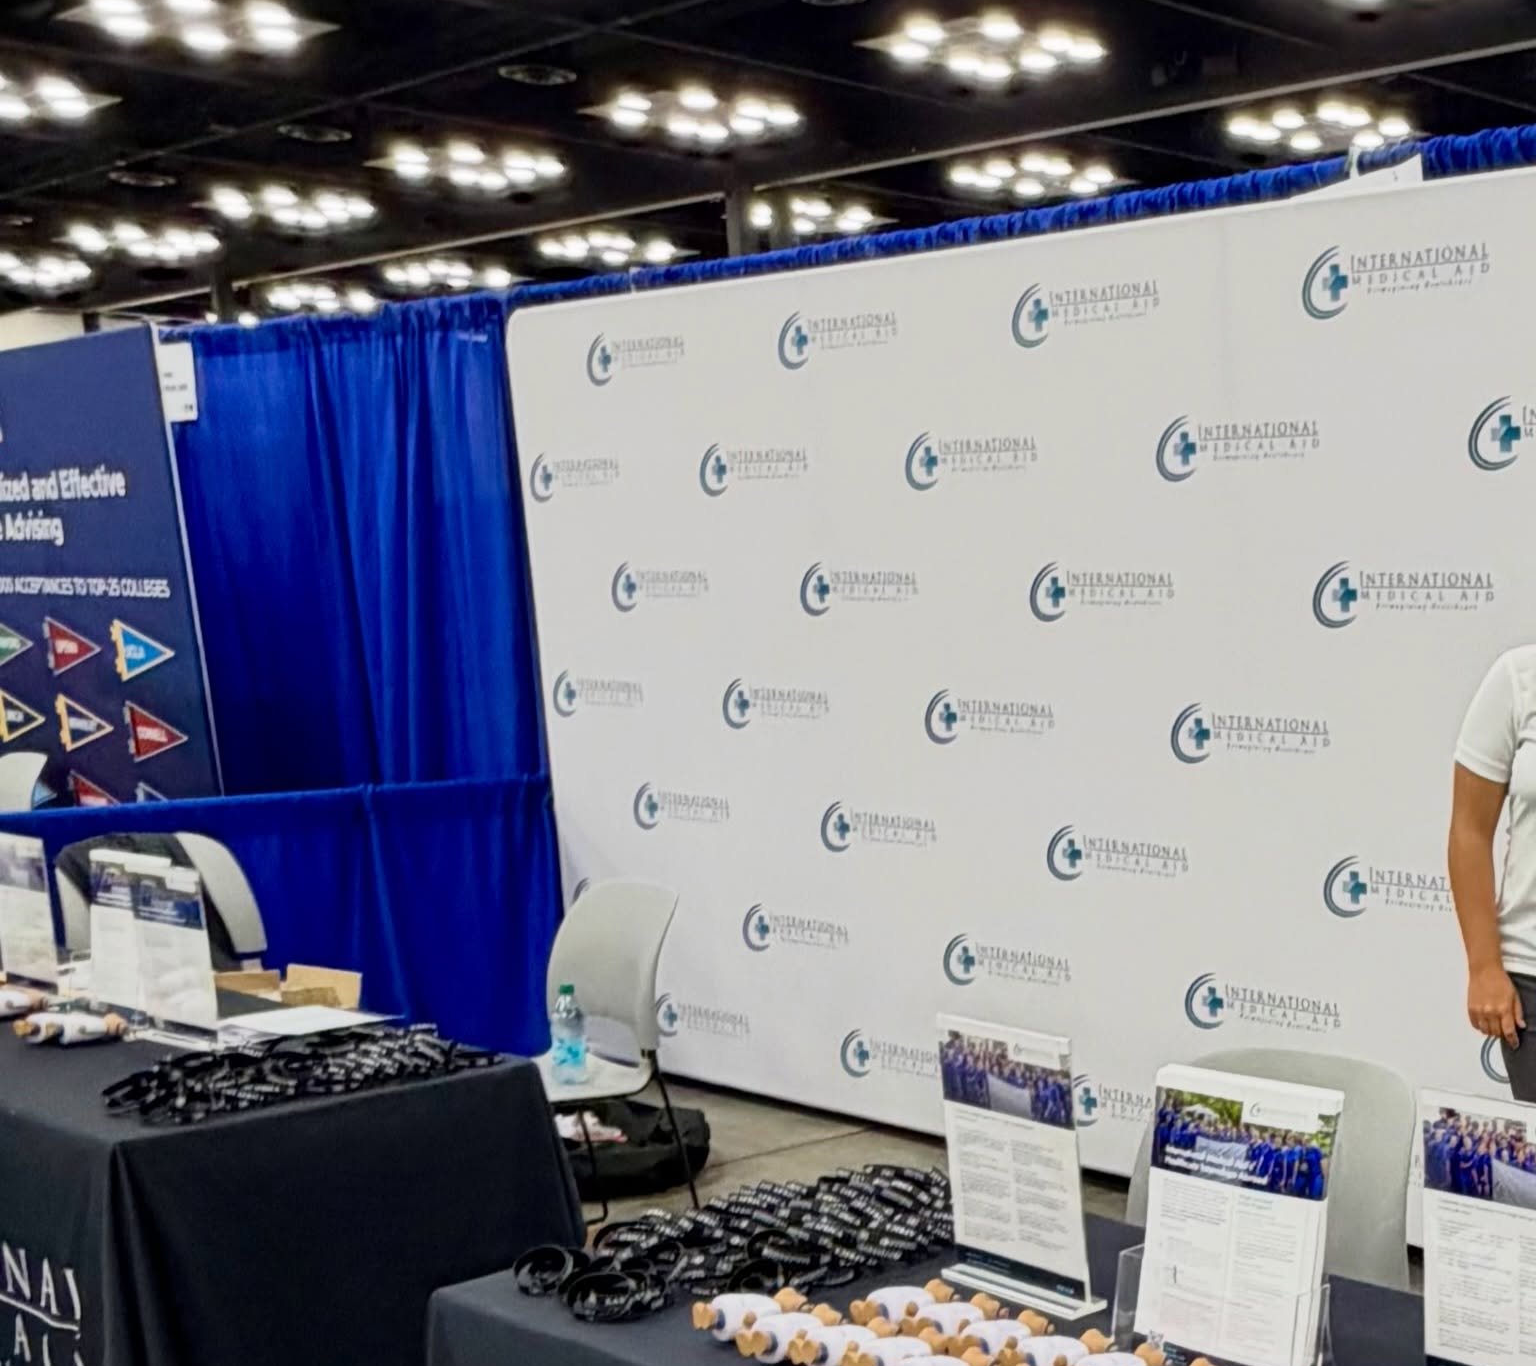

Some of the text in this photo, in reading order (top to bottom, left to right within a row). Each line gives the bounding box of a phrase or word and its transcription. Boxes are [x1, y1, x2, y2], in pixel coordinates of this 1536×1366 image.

[1351, 242, 1489, 271] INTERNATIONAL
[1351, 262, 1490, 286] MEDICAL AID
[1049, 279, 1159, 305] INTERNATIONAL
[1198, 420, 1319, 439] INTERNATIONAL
[938, 437, 1036, 452] INTERNATIONAL
[1199, 438, 1320, 453] MEDICAL AID
[59, 465, 126, 499] Effective
[5, 510, 64, 546] Advising
[1066, 570, 1173, 586] INTERNATIONAL
[1359, 570, 1493, 587] INTERNATIONAL
[1361, 589, 1494, 602] MEDICAL AID
[1212, 712, 1329, 734] INTERNATIONAL
[1213, 729, 1330, 747] MEDICAL AID
[1083, 834, 1188, 860] INTERNATIONAL
[1369, 866, 1446, 891] INTERNAT
[1225, 983, 1340, 1016] INTERNATIONAL
